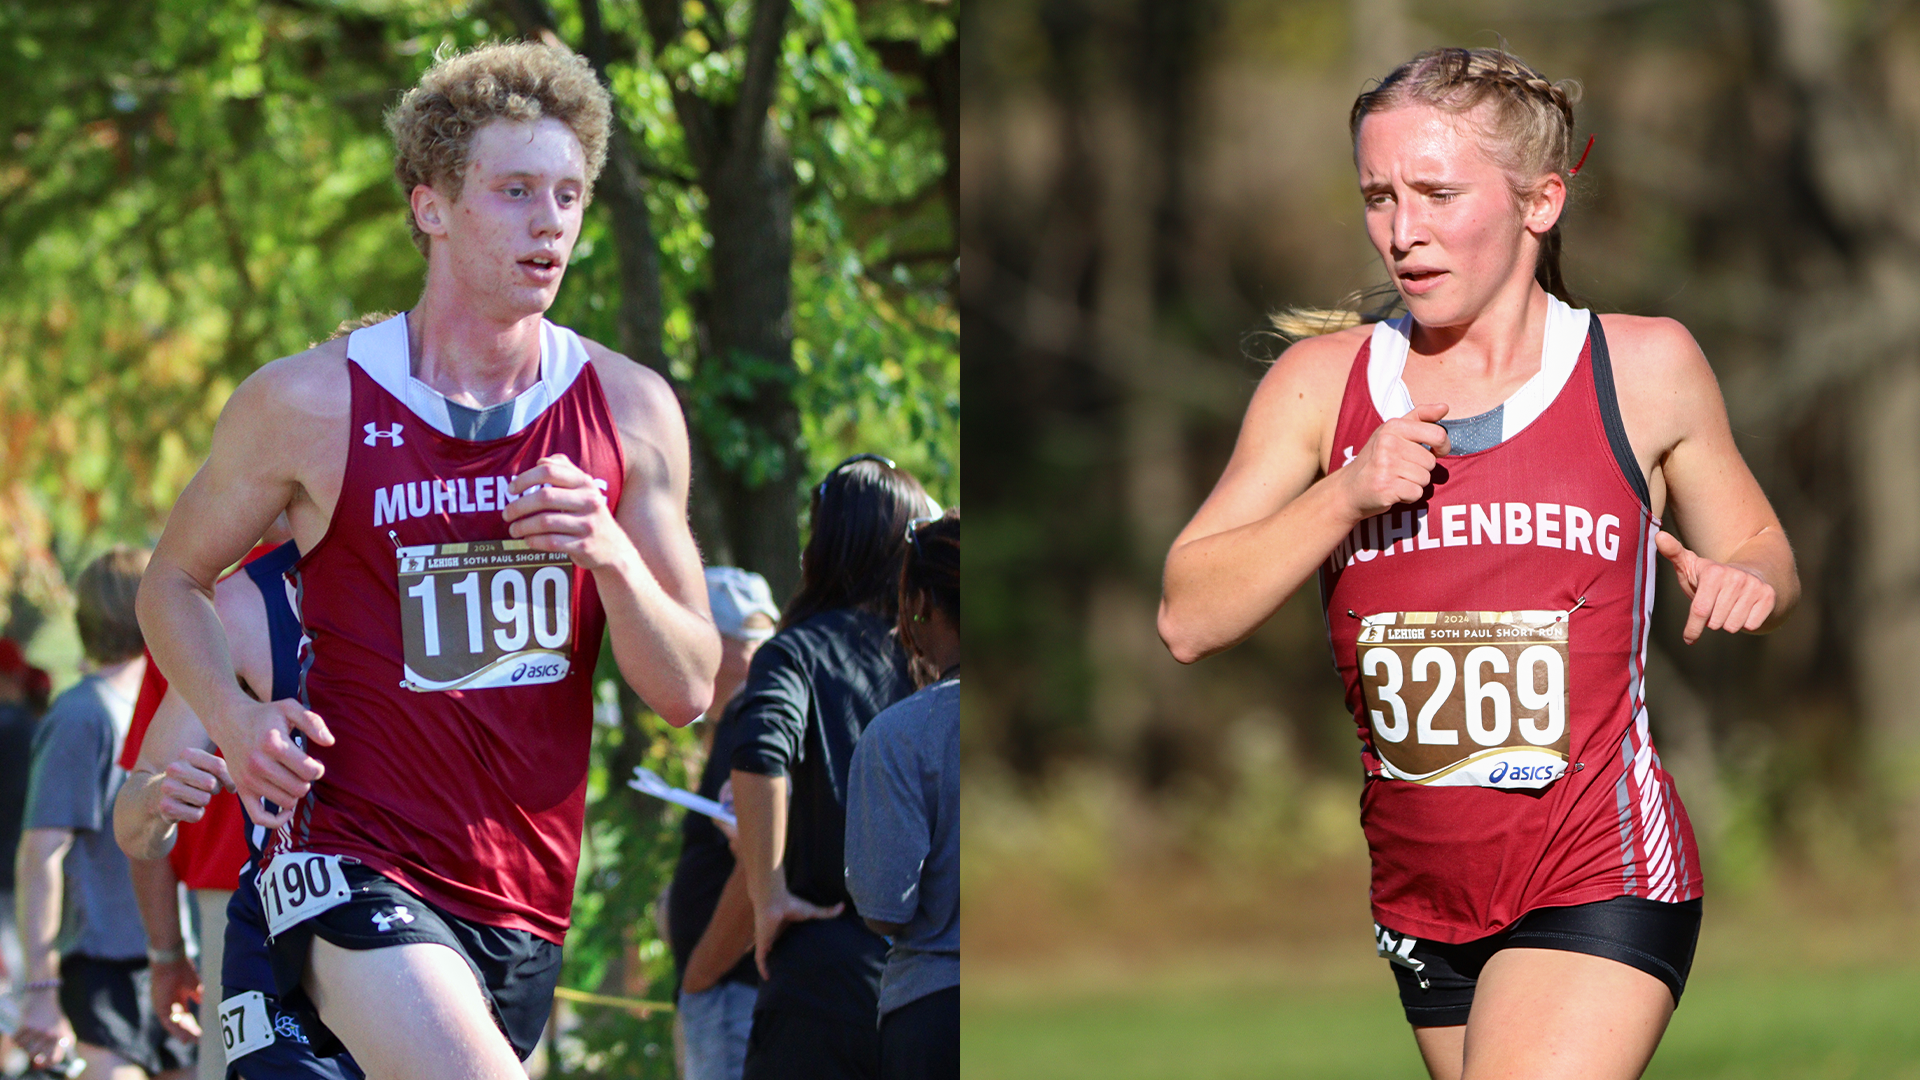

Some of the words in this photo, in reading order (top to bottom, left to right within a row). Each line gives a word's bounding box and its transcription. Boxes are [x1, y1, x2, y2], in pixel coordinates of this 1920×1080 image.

[373, 475, 608, 527] MUHLEN
[428, 557, 459, 568] LEHIGH
[491, 553, 514, 563] PAUL
[515, 552, 546, 562] SHORT
[548, 552, 568, 561] RUN
[474, 544, 496, 552] 2024
[408, 566, 570, 657] 1190
[1387, 628, 1426, 640] LEHIGH
[1464, 629, 1493, 638] PAUL
[1496, 628, 1534, 638] SHORT
[1538, 627, 1563, 637] RUN
[1444, 615, 1470, 624] 2024
[1362, 645, 1566, 746] 3269
[263, 856, 331, 924] 1190
[220, 1005, 245, 1050] 67
